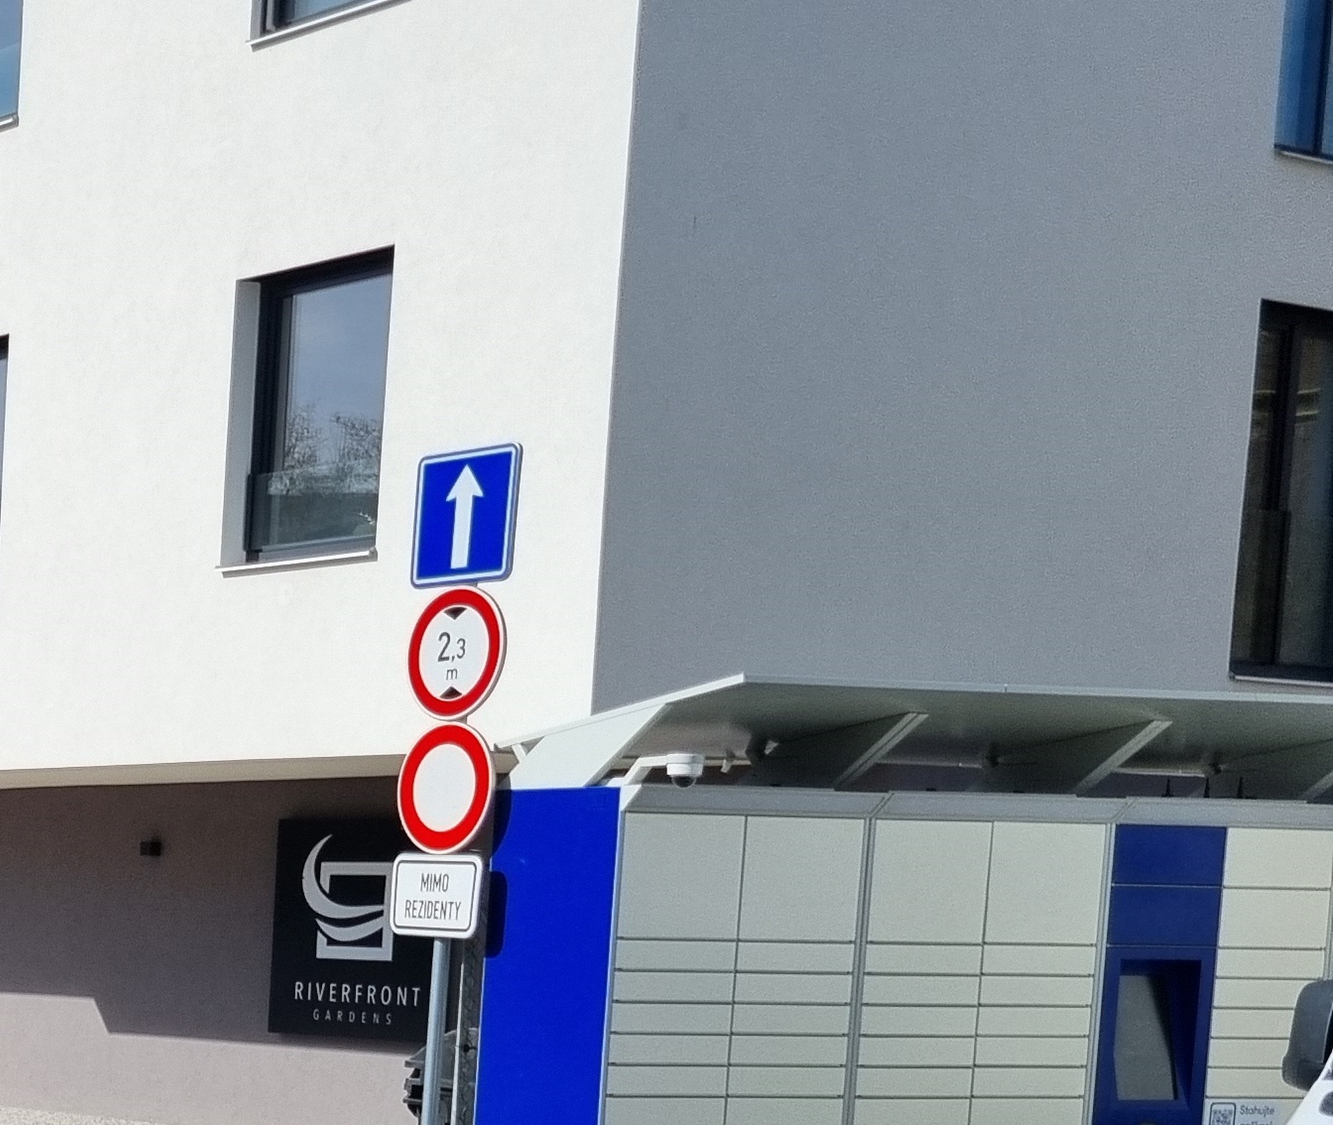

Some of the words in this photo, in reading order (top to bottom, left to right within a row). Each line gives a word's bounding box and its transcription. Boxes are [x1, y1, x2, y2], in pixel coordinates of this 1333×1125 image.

[437, 631, 466, 663] 2,3
[445, 668, 458, 681] m
[419, 872, 450, 893] MIMO
[404, 899, 462, 921] REZIDENTY
[294, 981, 421, 1007] RIVERFRONT
[312, 1008, 393, 1025] GARDENS
